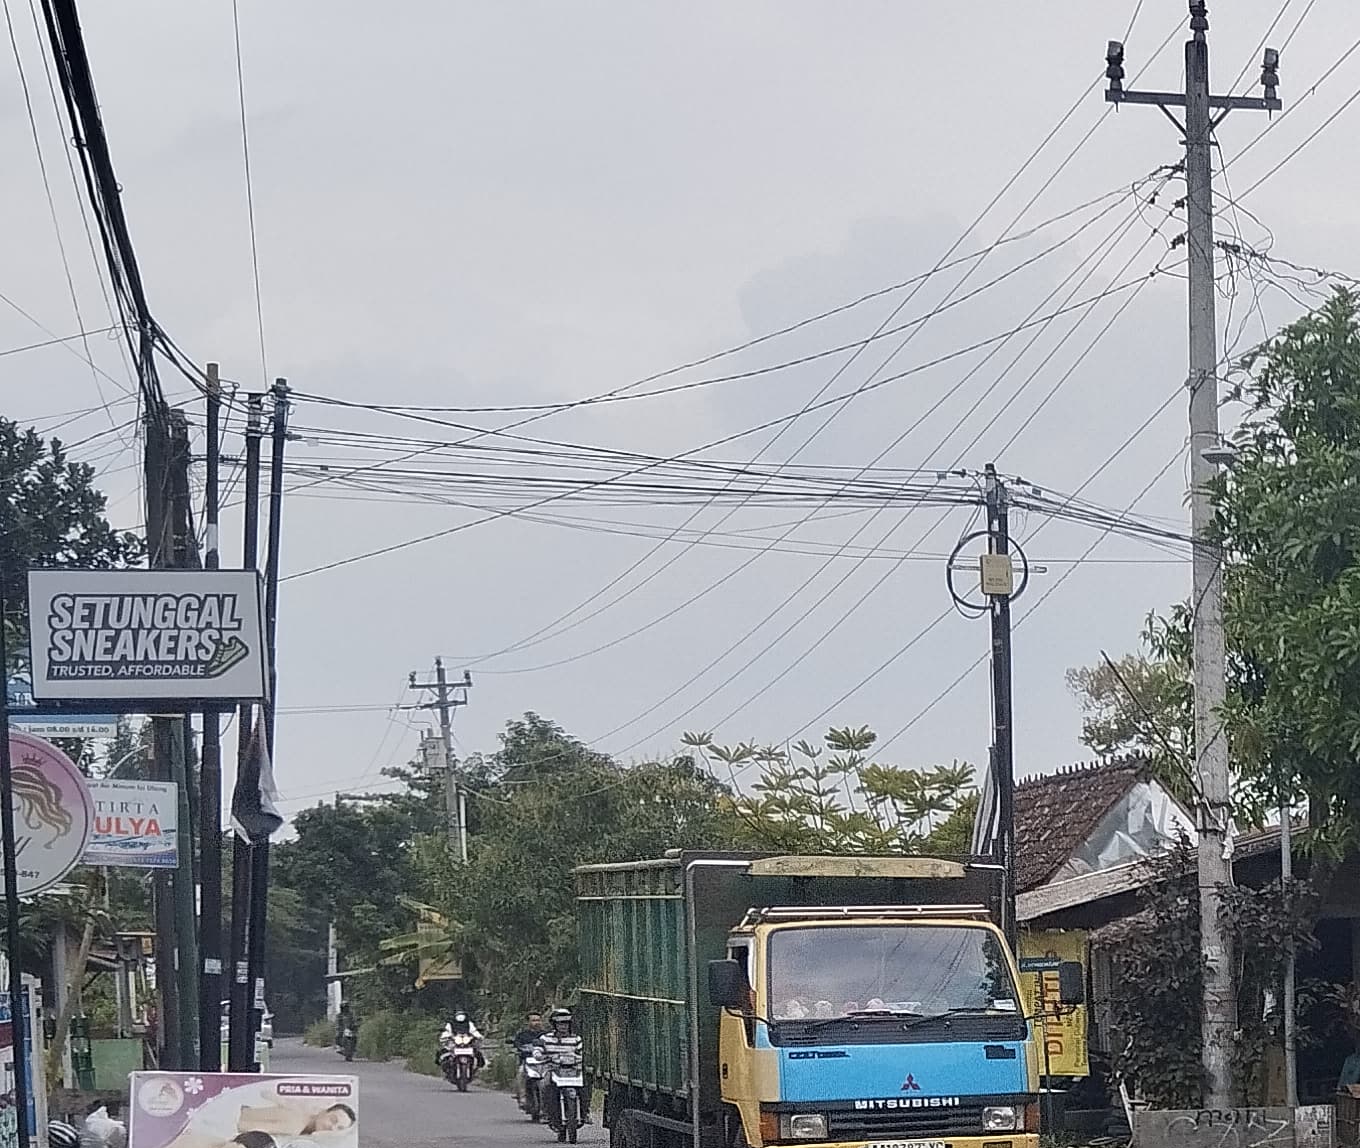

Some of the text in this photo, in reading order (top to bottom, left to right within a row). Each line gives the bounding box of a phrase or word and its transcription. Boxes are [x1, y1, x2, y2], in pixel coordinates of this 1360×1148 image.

[50, 594, 242, 630] SETUNGGAL
[50, 629, 221, 661] SNEAKERS
[52, 663, 206, 678] TRUSTED, AFFORDABLE
[96, 800, 159, 815] TIRTA
[95, 815, 162, 837] ULYA
[311, 1085, 349, 1095] WANITA
[855, 1097, 960, 1109] MITSUBISHI
